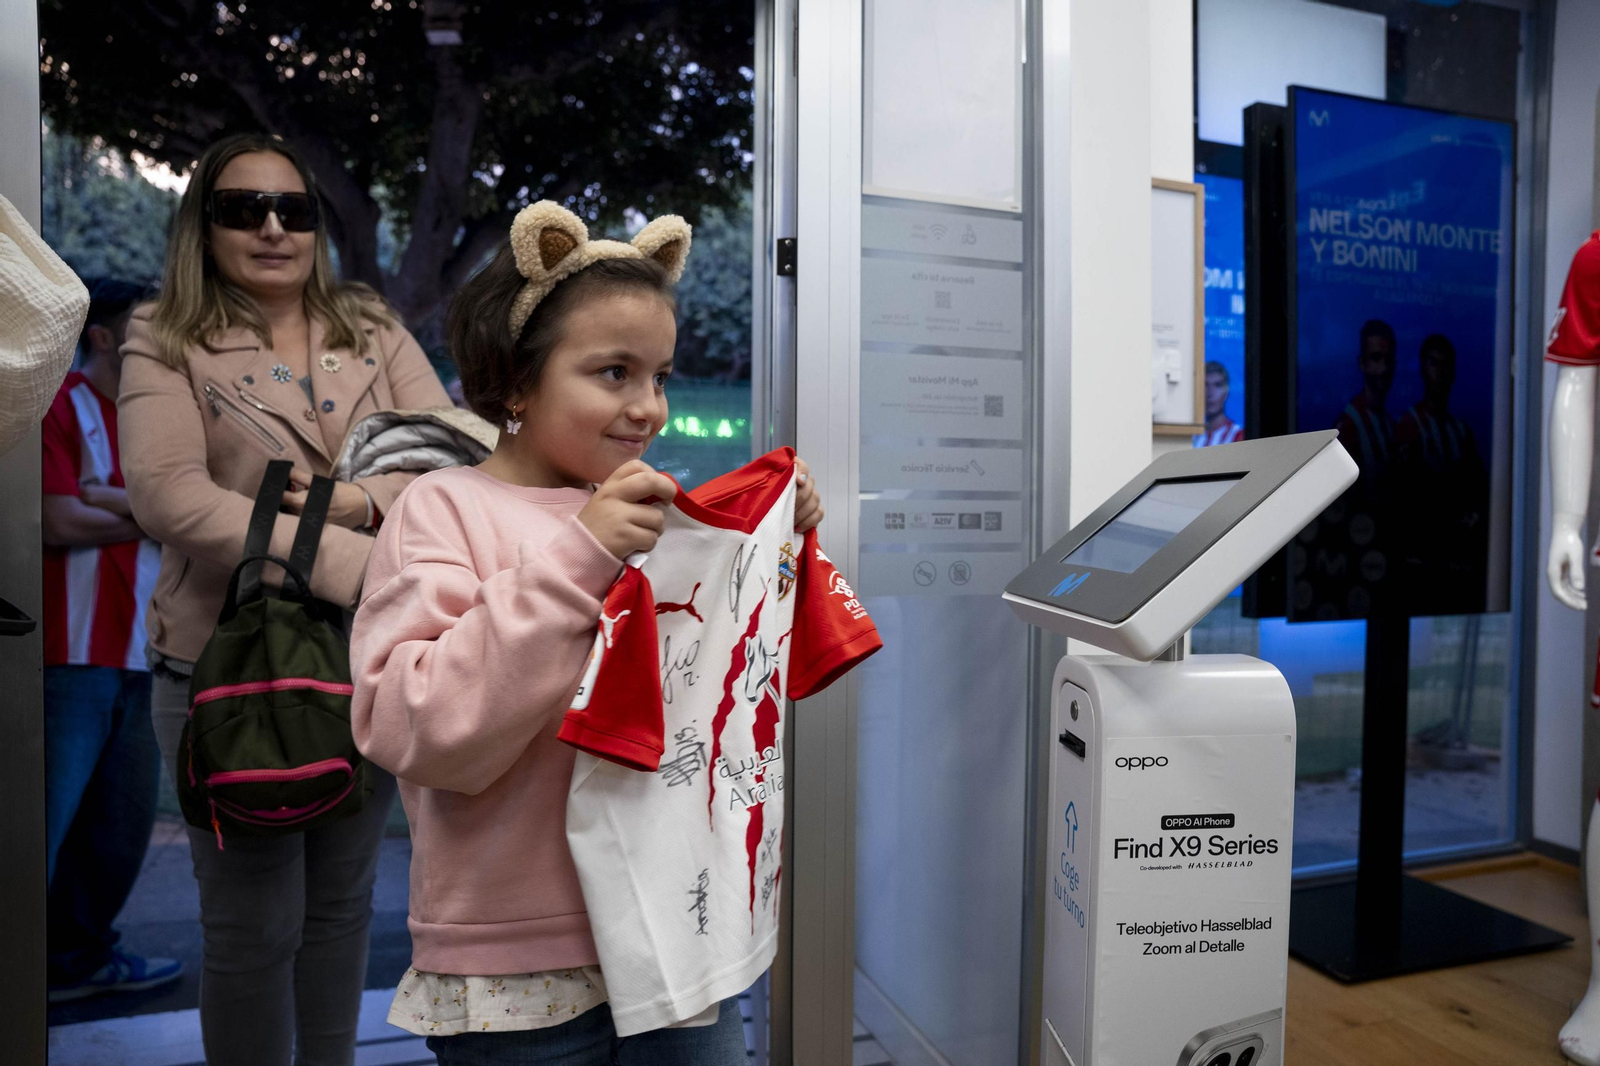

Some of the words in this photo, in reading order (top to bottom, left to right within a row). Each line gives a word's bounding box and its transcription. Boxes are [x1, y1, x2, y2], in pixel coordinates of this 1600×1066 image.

[1309, 207, 1411, 244] NELSON
[1310, 238, 1328, 264] Y
[1333, 239, 1418, 273] BONINI
[1115, 756, 1169, 771] oppo
[1165, 818, 1192, 827] OPPO
[1193, 817, 1203, 826] AI
[1204, 817, 1231, 826] Phone
[1114, 837, 1163, 859] Find
[1169, 835, 1202, 858] X9
[1207, 833, 1279, 856] Series
[1061, 852, 1080, 891] Coge
[1187, 860, 1254, 870] HASSELBLAD
[1054, 875, 1062, 900] tu
[1063, 887, 1085, 929] turno
[1116, 920, 1198, 937] Teleobjetivo
[1200, 916, 1272, 932] Hasselblad
[1142, 942, 1182, 956] Zoom
[1185, 940, 1196, 954] al
[1199, 939, 1245, 953] Detalle
